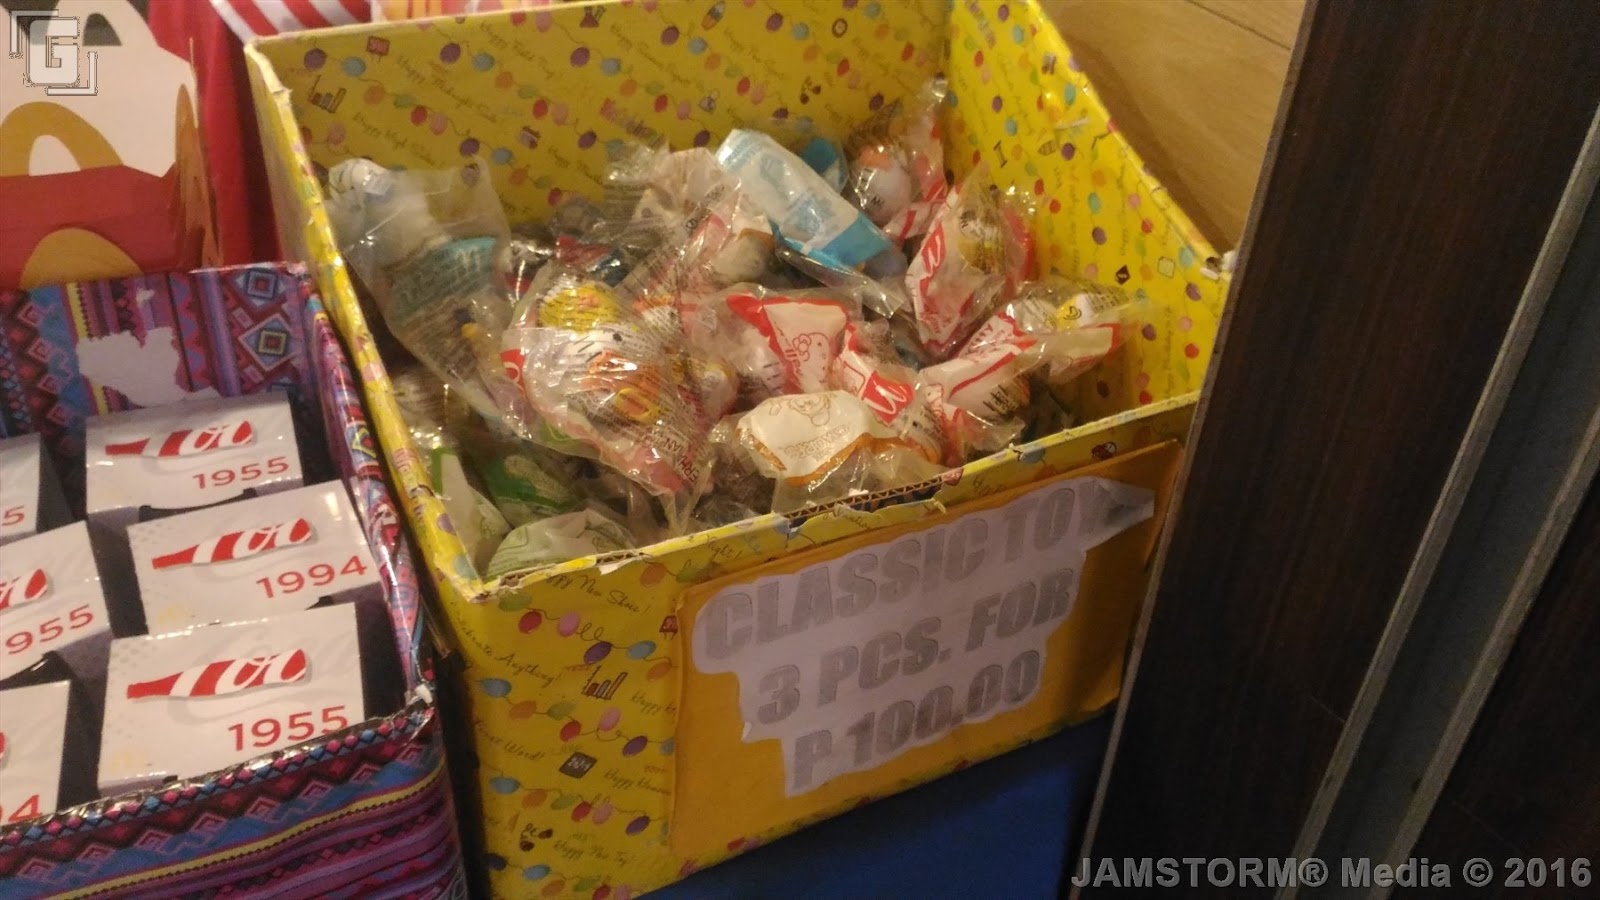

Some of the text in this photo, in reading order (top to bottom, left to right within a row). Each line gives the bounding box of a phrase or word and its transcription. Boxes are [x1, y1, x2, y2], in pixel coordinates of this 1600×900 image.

[193, 456, 289, 490] 1955
[257, 555, 368, 599] 1994
[704, 516, 988, 660] CLASSIC
[756, 568, 1075, 725] 3 PCS. FOR
[228, 704, 350, 753] 1955
[791, 649, 1041, 794] P 100.00
